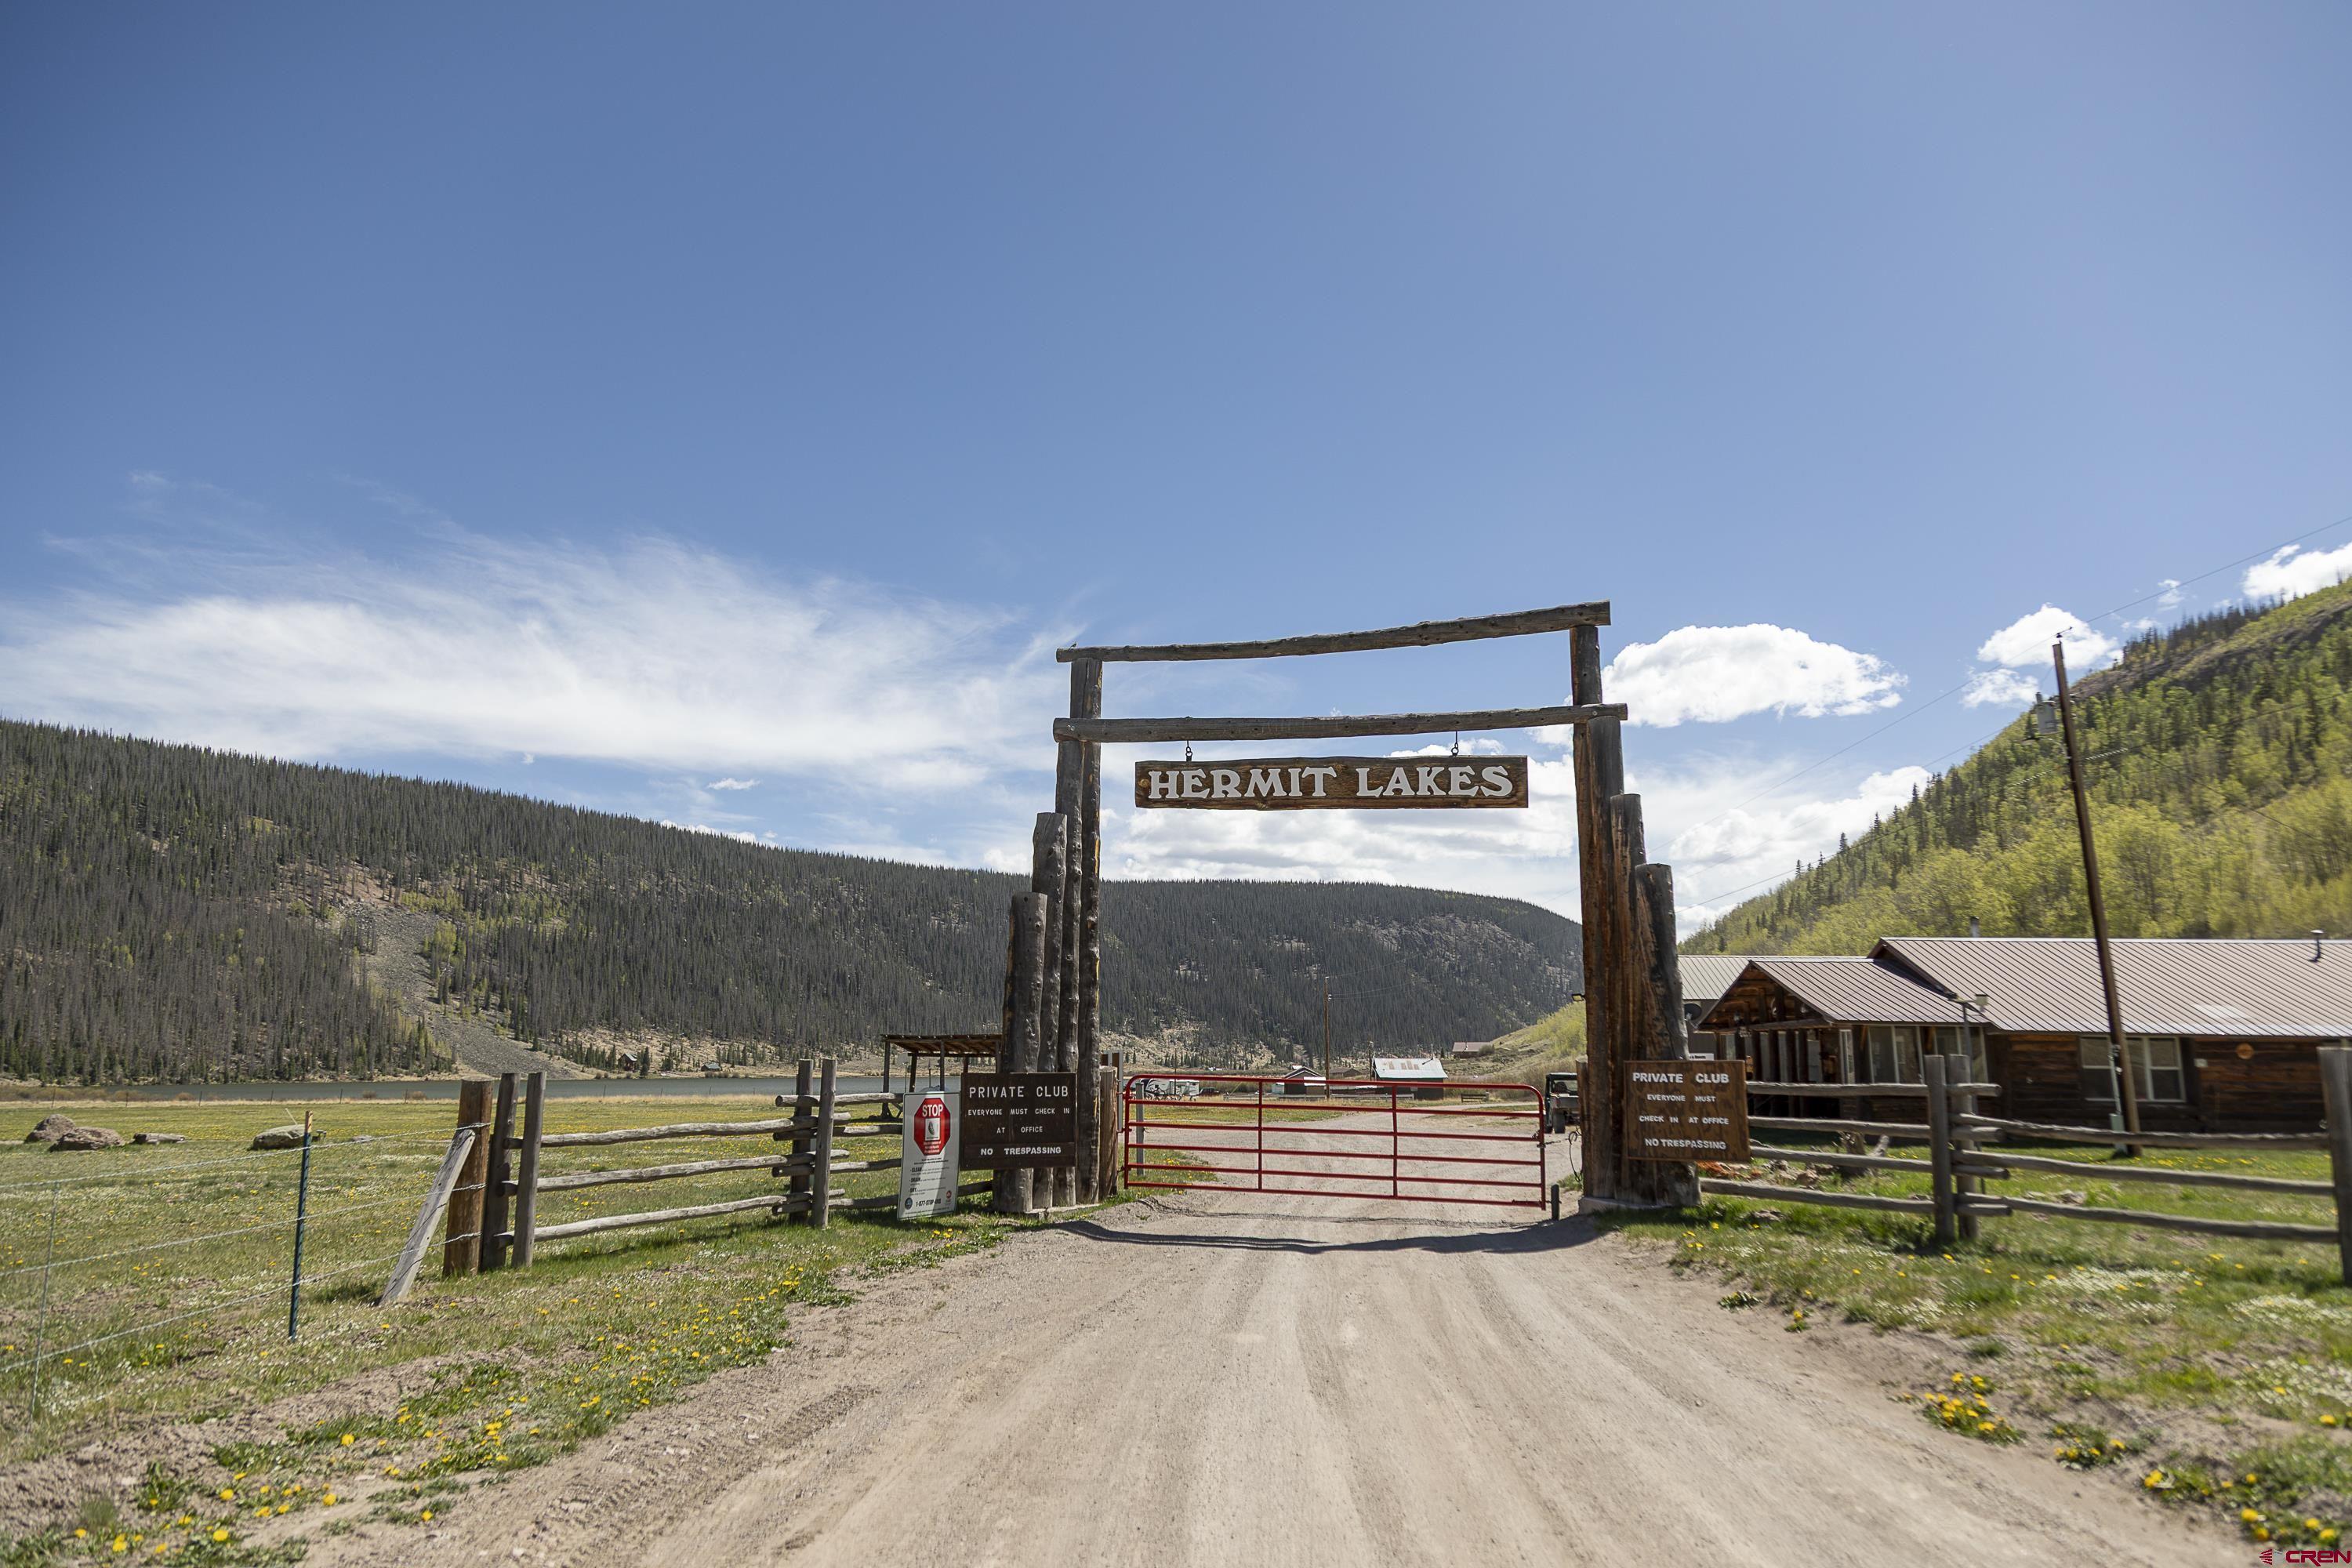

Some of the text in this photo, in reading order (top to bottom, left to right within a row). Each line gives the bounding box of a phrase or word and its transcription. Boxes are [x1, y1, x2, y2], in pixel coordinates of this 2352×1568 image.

[1148, 765, 1514, 800] HERMIT LAKES
[1632, 1073, 1730, 1083] PRIVATE CLUB
[969, 1086, 1069, 1098] PRIVATE CLUB
[922, 1104, 943, 1117] STOP
[1644, 1138, 1726, 1149] NO TRESPASSING
[1004, 1146, 1062, 1155] TRESPASSING
